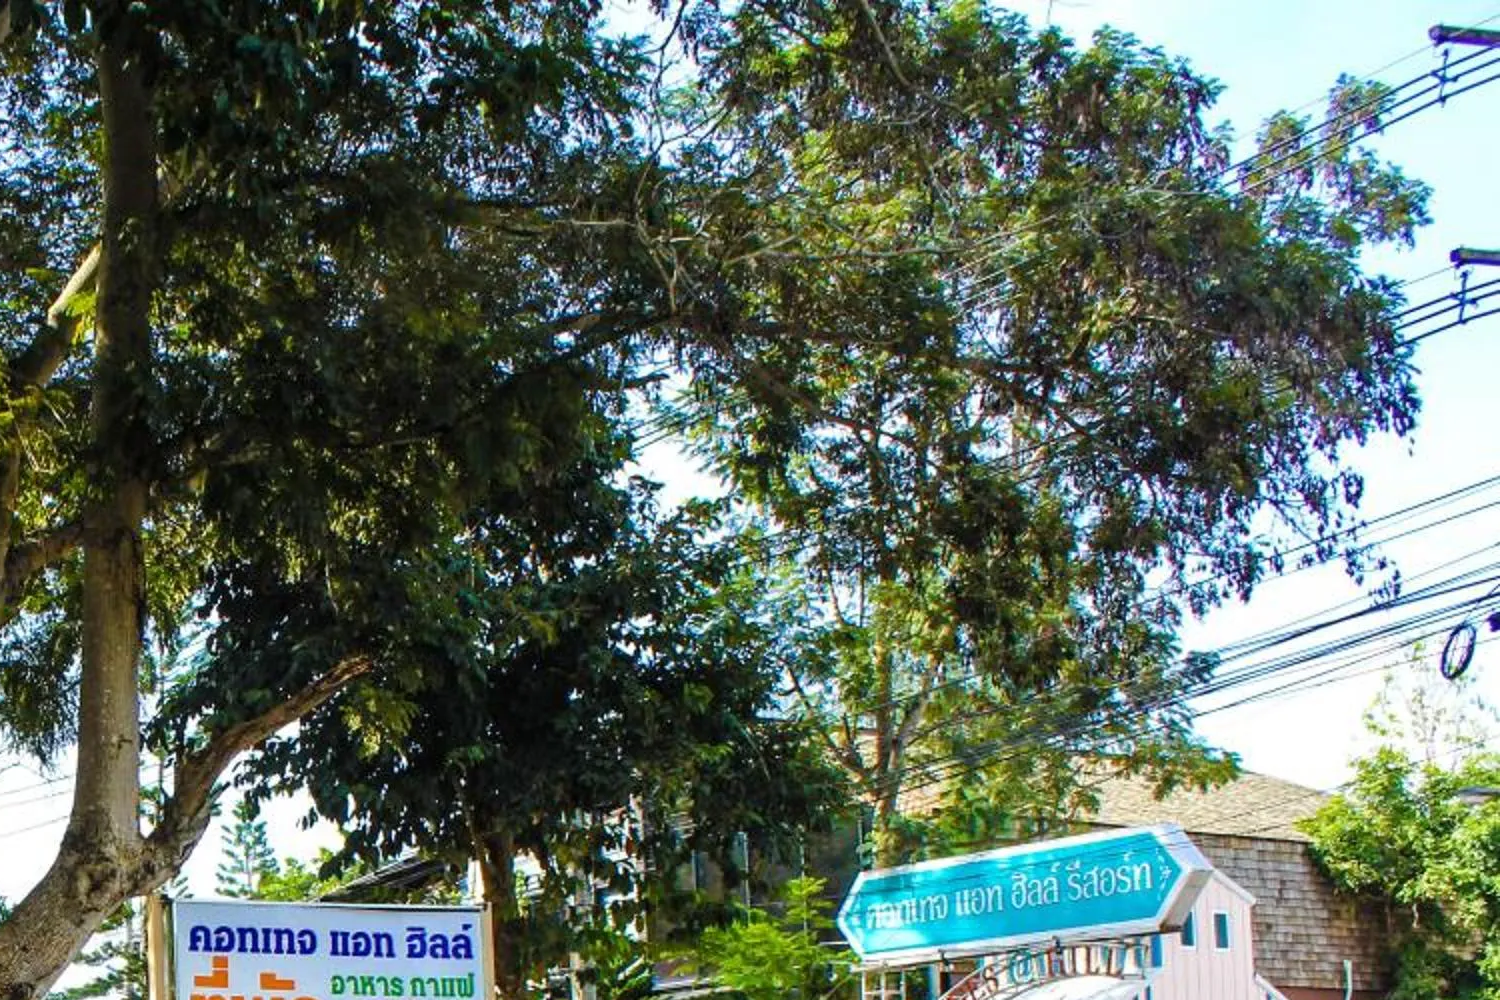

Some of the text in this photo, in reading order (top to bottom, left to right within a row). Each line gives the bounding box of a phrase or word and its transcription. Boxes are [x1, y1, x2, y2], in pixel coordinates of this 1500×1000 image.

[954, 884, 1003, 916] แอท
[1011, 862, 1059, 909] ฮิลล์
[1067, 852, 1153, 899] รีสอร์ท
[188, 924, 474, 960] คอทเทจ แอท ฮิลล์
[331, 972, 475, 998] อาหาร กาแฟ
